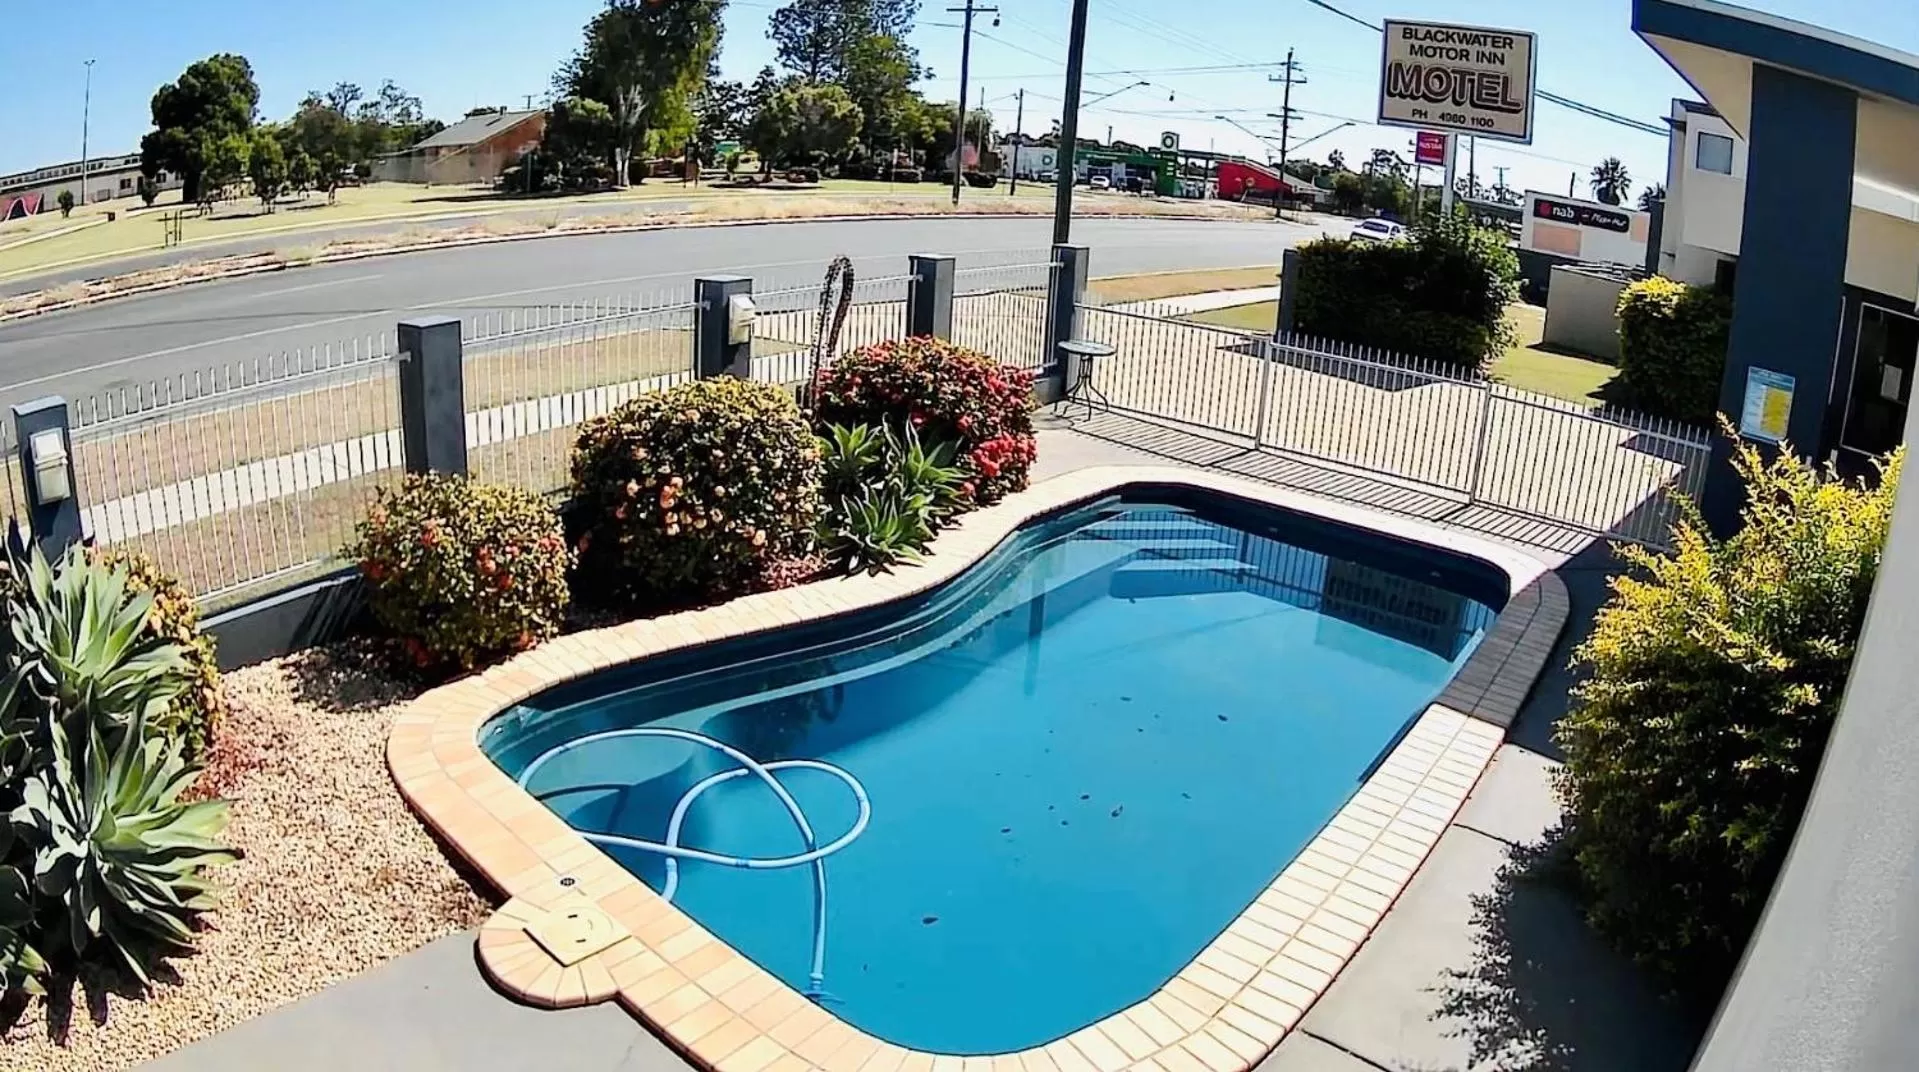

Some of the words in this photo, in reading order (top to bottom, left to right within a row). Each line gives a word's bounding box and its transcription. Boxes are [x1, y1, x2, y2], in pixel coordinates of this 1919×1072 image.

[1402, 27, 1514, 50] BLACKWATER
[1409, 43, 1470, 62] MOTOR
[1476, 49, 1505, 65] INN
[1387, 61, 1524, 114] MOTEL
[1412, 108, 1428, 119] PH
[1471, 116, 1494, 128] 1100
[1552, 206, 1575, 219] nab
